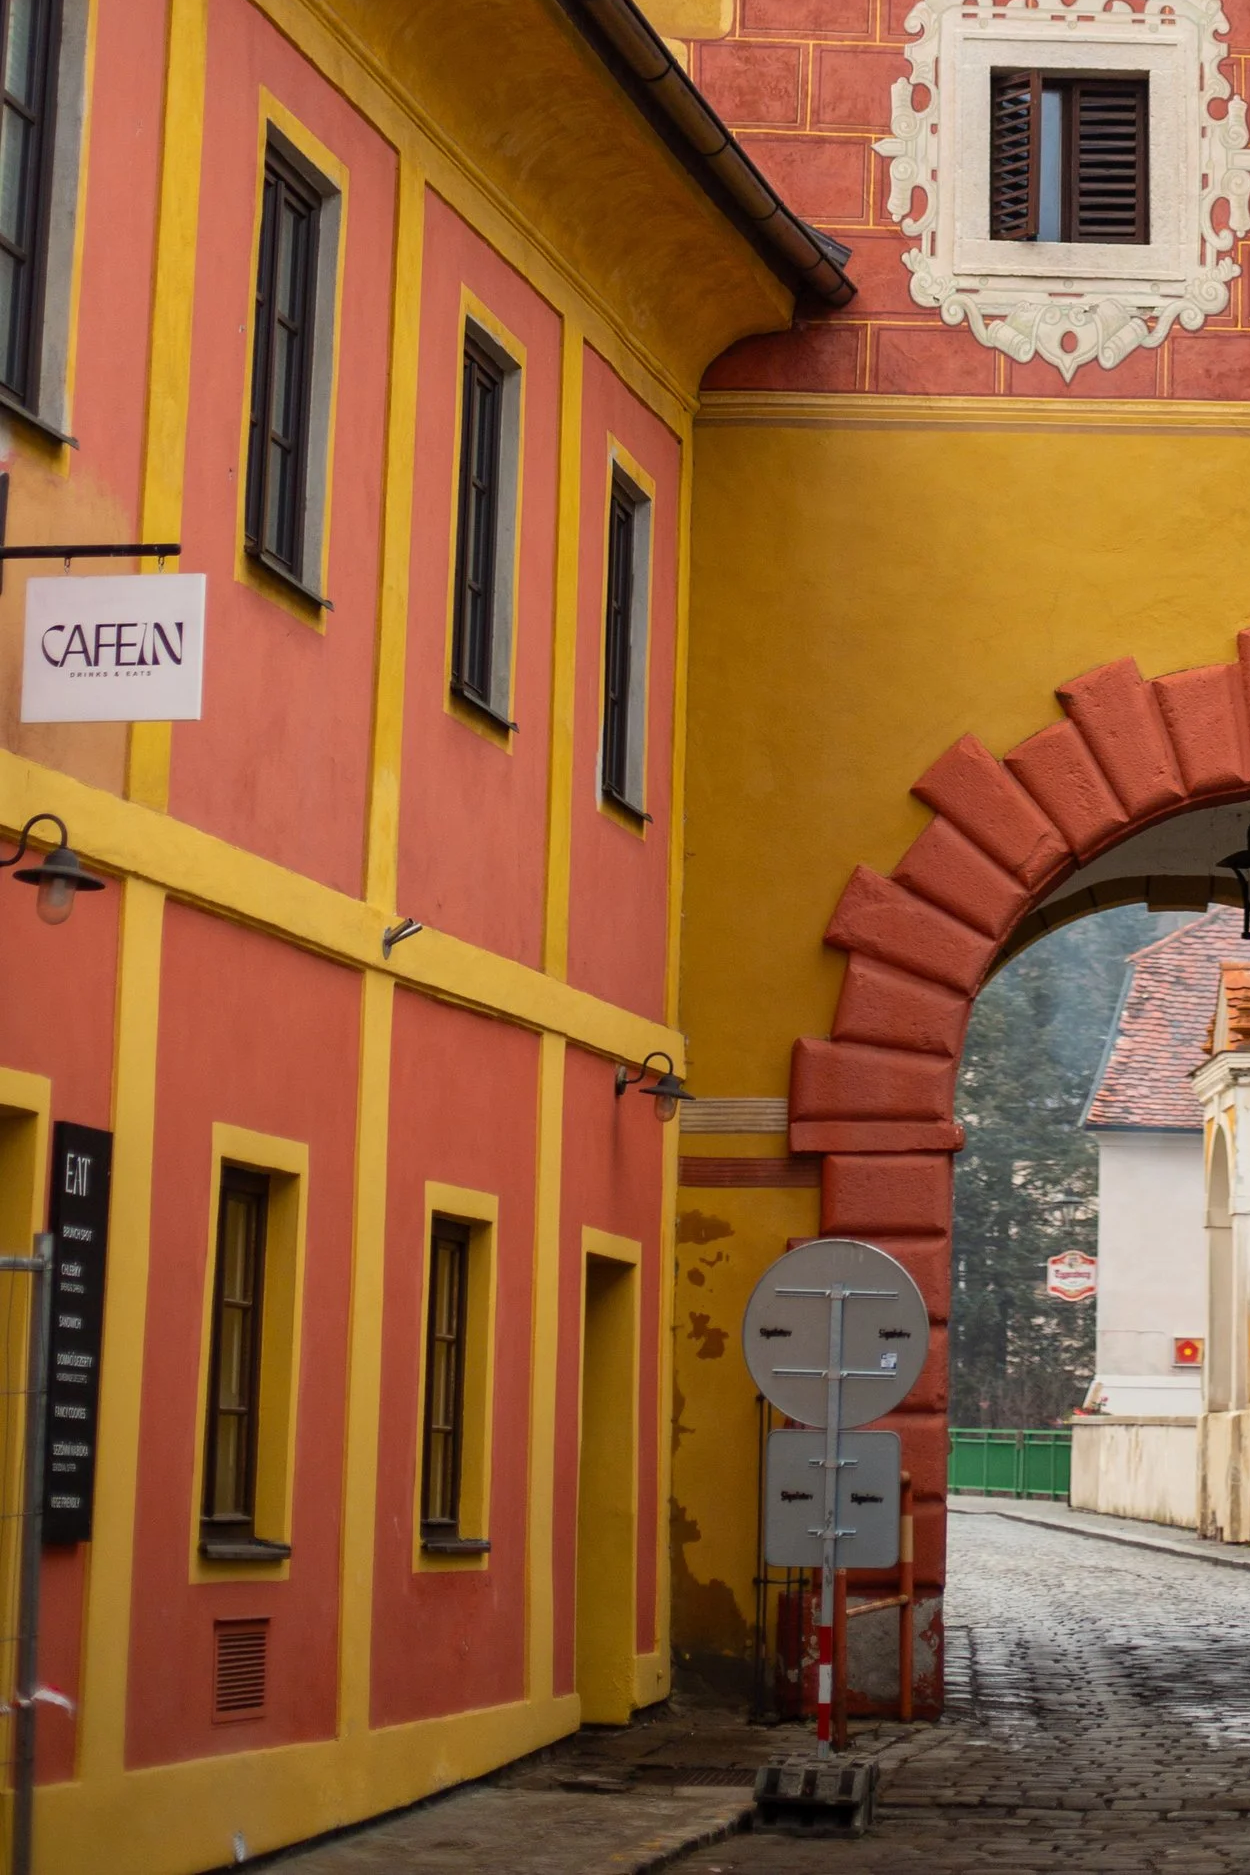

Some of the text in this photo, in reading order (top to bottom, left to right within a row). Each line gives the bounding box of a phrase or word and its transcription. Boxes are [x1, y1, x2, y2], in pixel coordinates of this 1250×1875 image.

[41, 622, 184, 668] CAFEIN
[65, 1153, 91, 1197] EAT
[63, 1225, 93, 1242] BRUNCH SPOT
